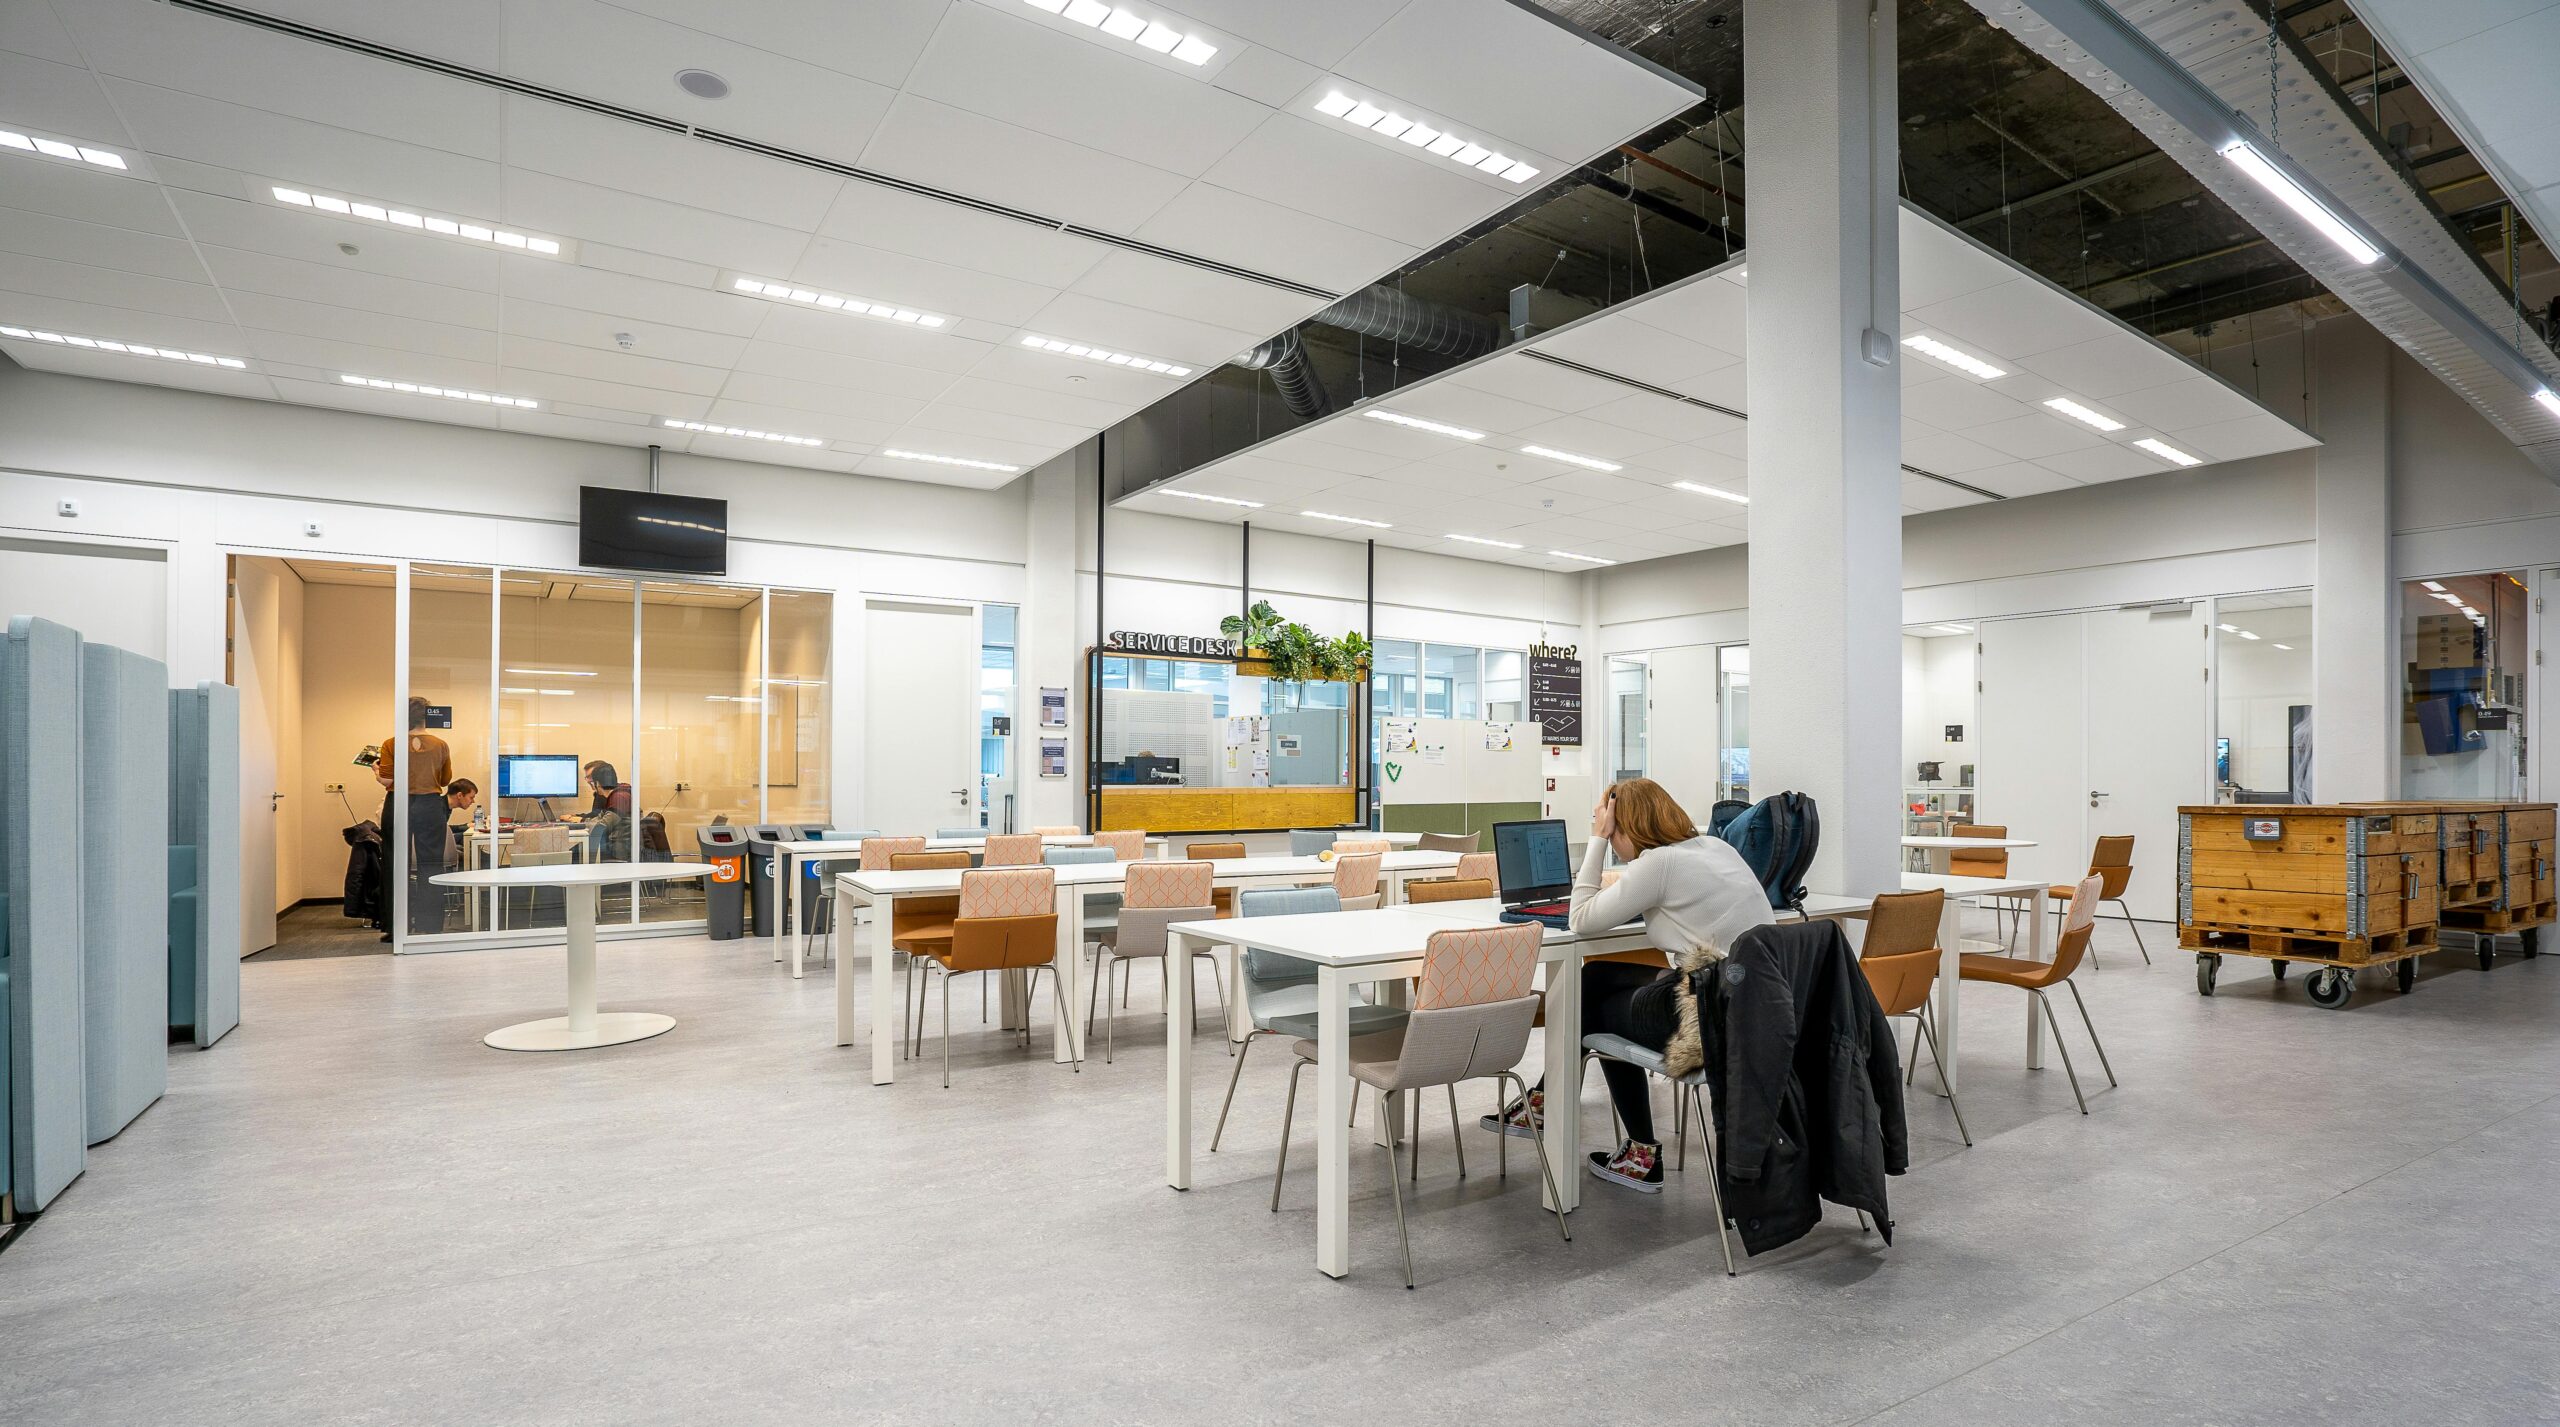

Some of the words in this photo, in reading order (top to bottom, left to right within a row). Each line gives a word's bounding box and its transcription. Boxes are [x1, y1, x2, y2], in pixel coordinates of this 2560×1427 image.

[1110, 630, 1190, 654] SERVICE
[1193, 636, 1237, 656] DESK
[1529, 640, 1577, 660] where?
